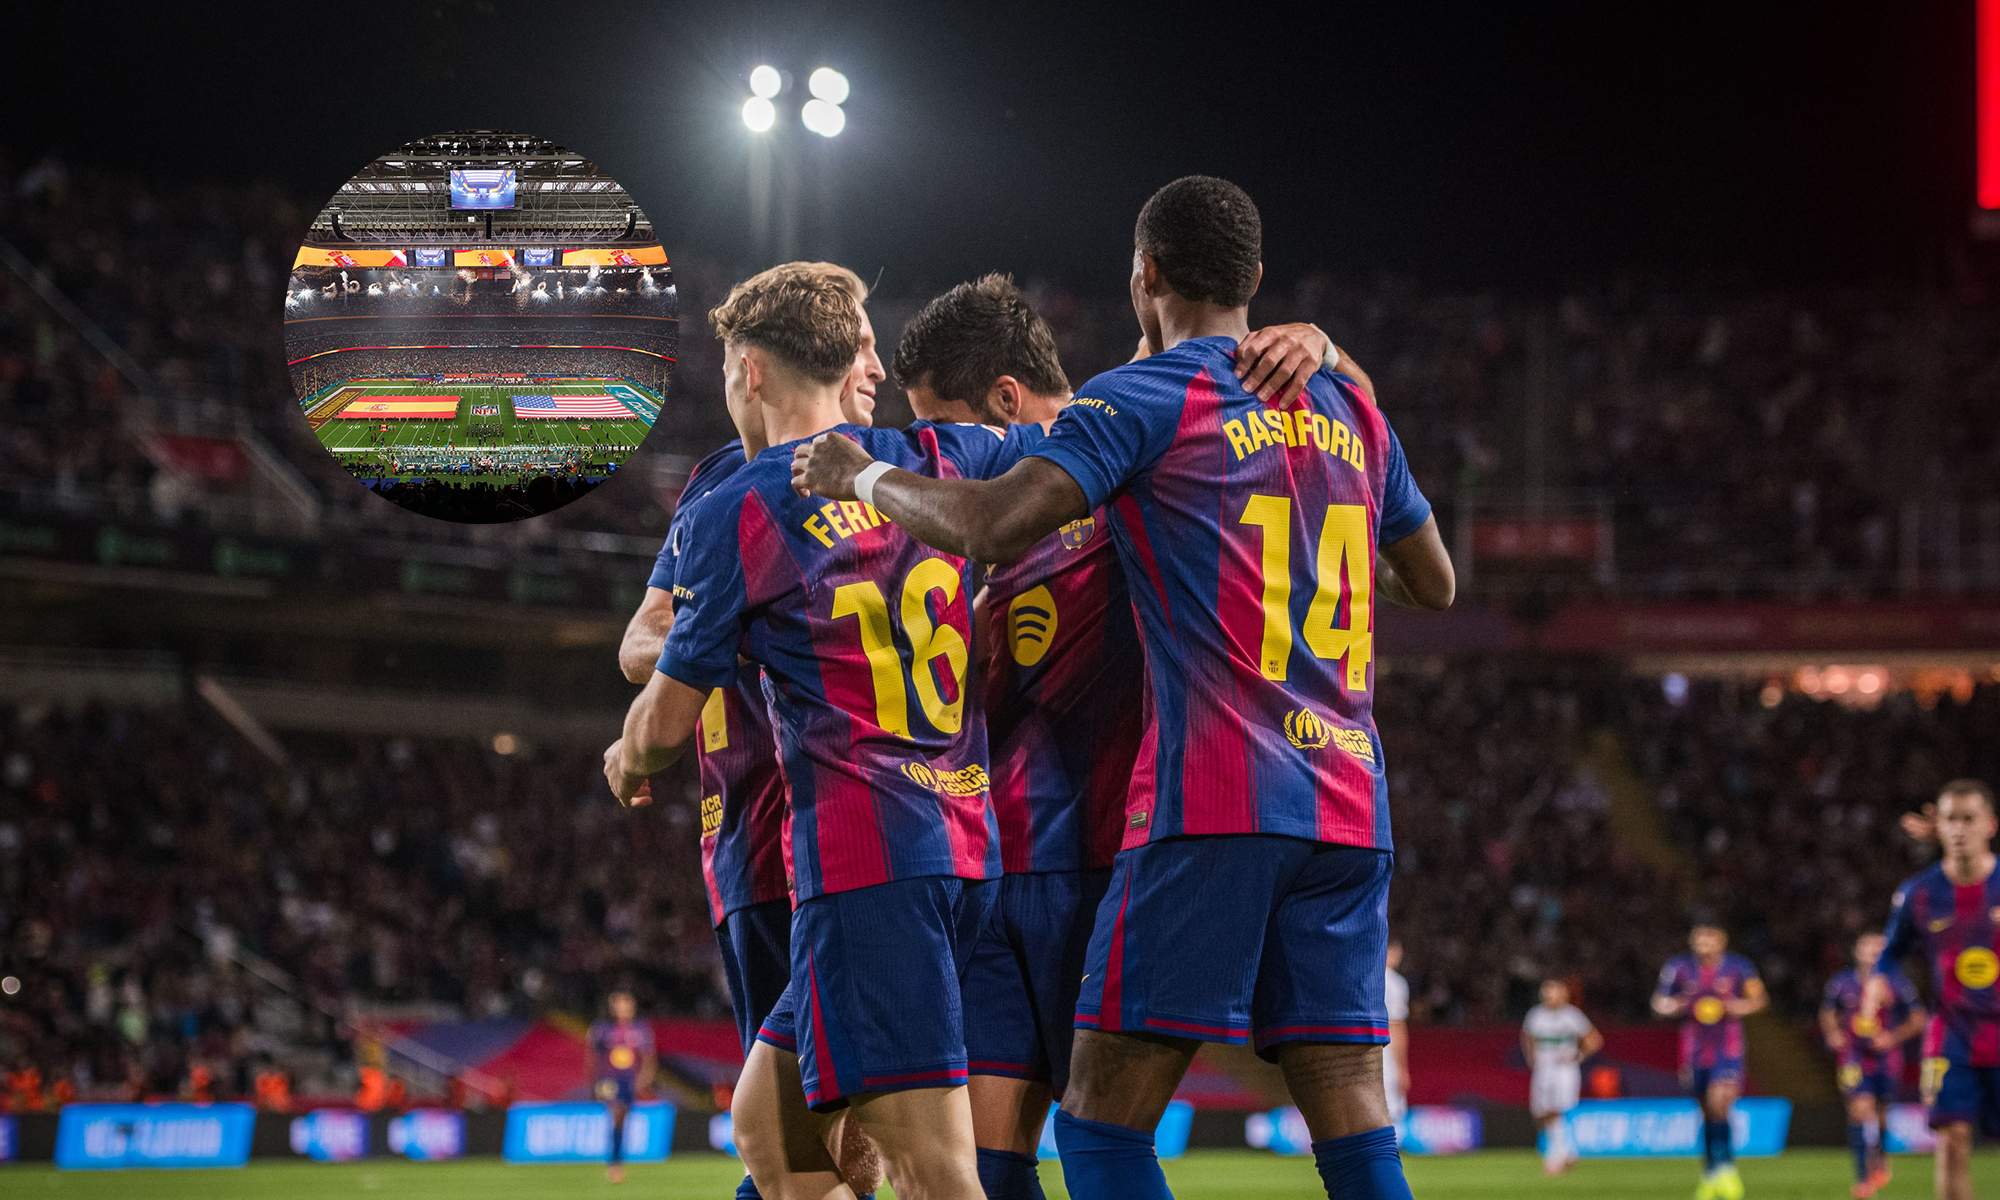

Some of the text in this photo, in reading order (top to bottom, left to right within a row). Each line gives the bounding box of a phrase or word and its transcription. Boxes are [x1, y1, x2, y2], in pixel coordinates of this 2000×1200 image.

[1222, 409, 1365, 473] RASHFORD
[831, 557, 969, 741] 16
[1239, 494, 1372, 692] 14
